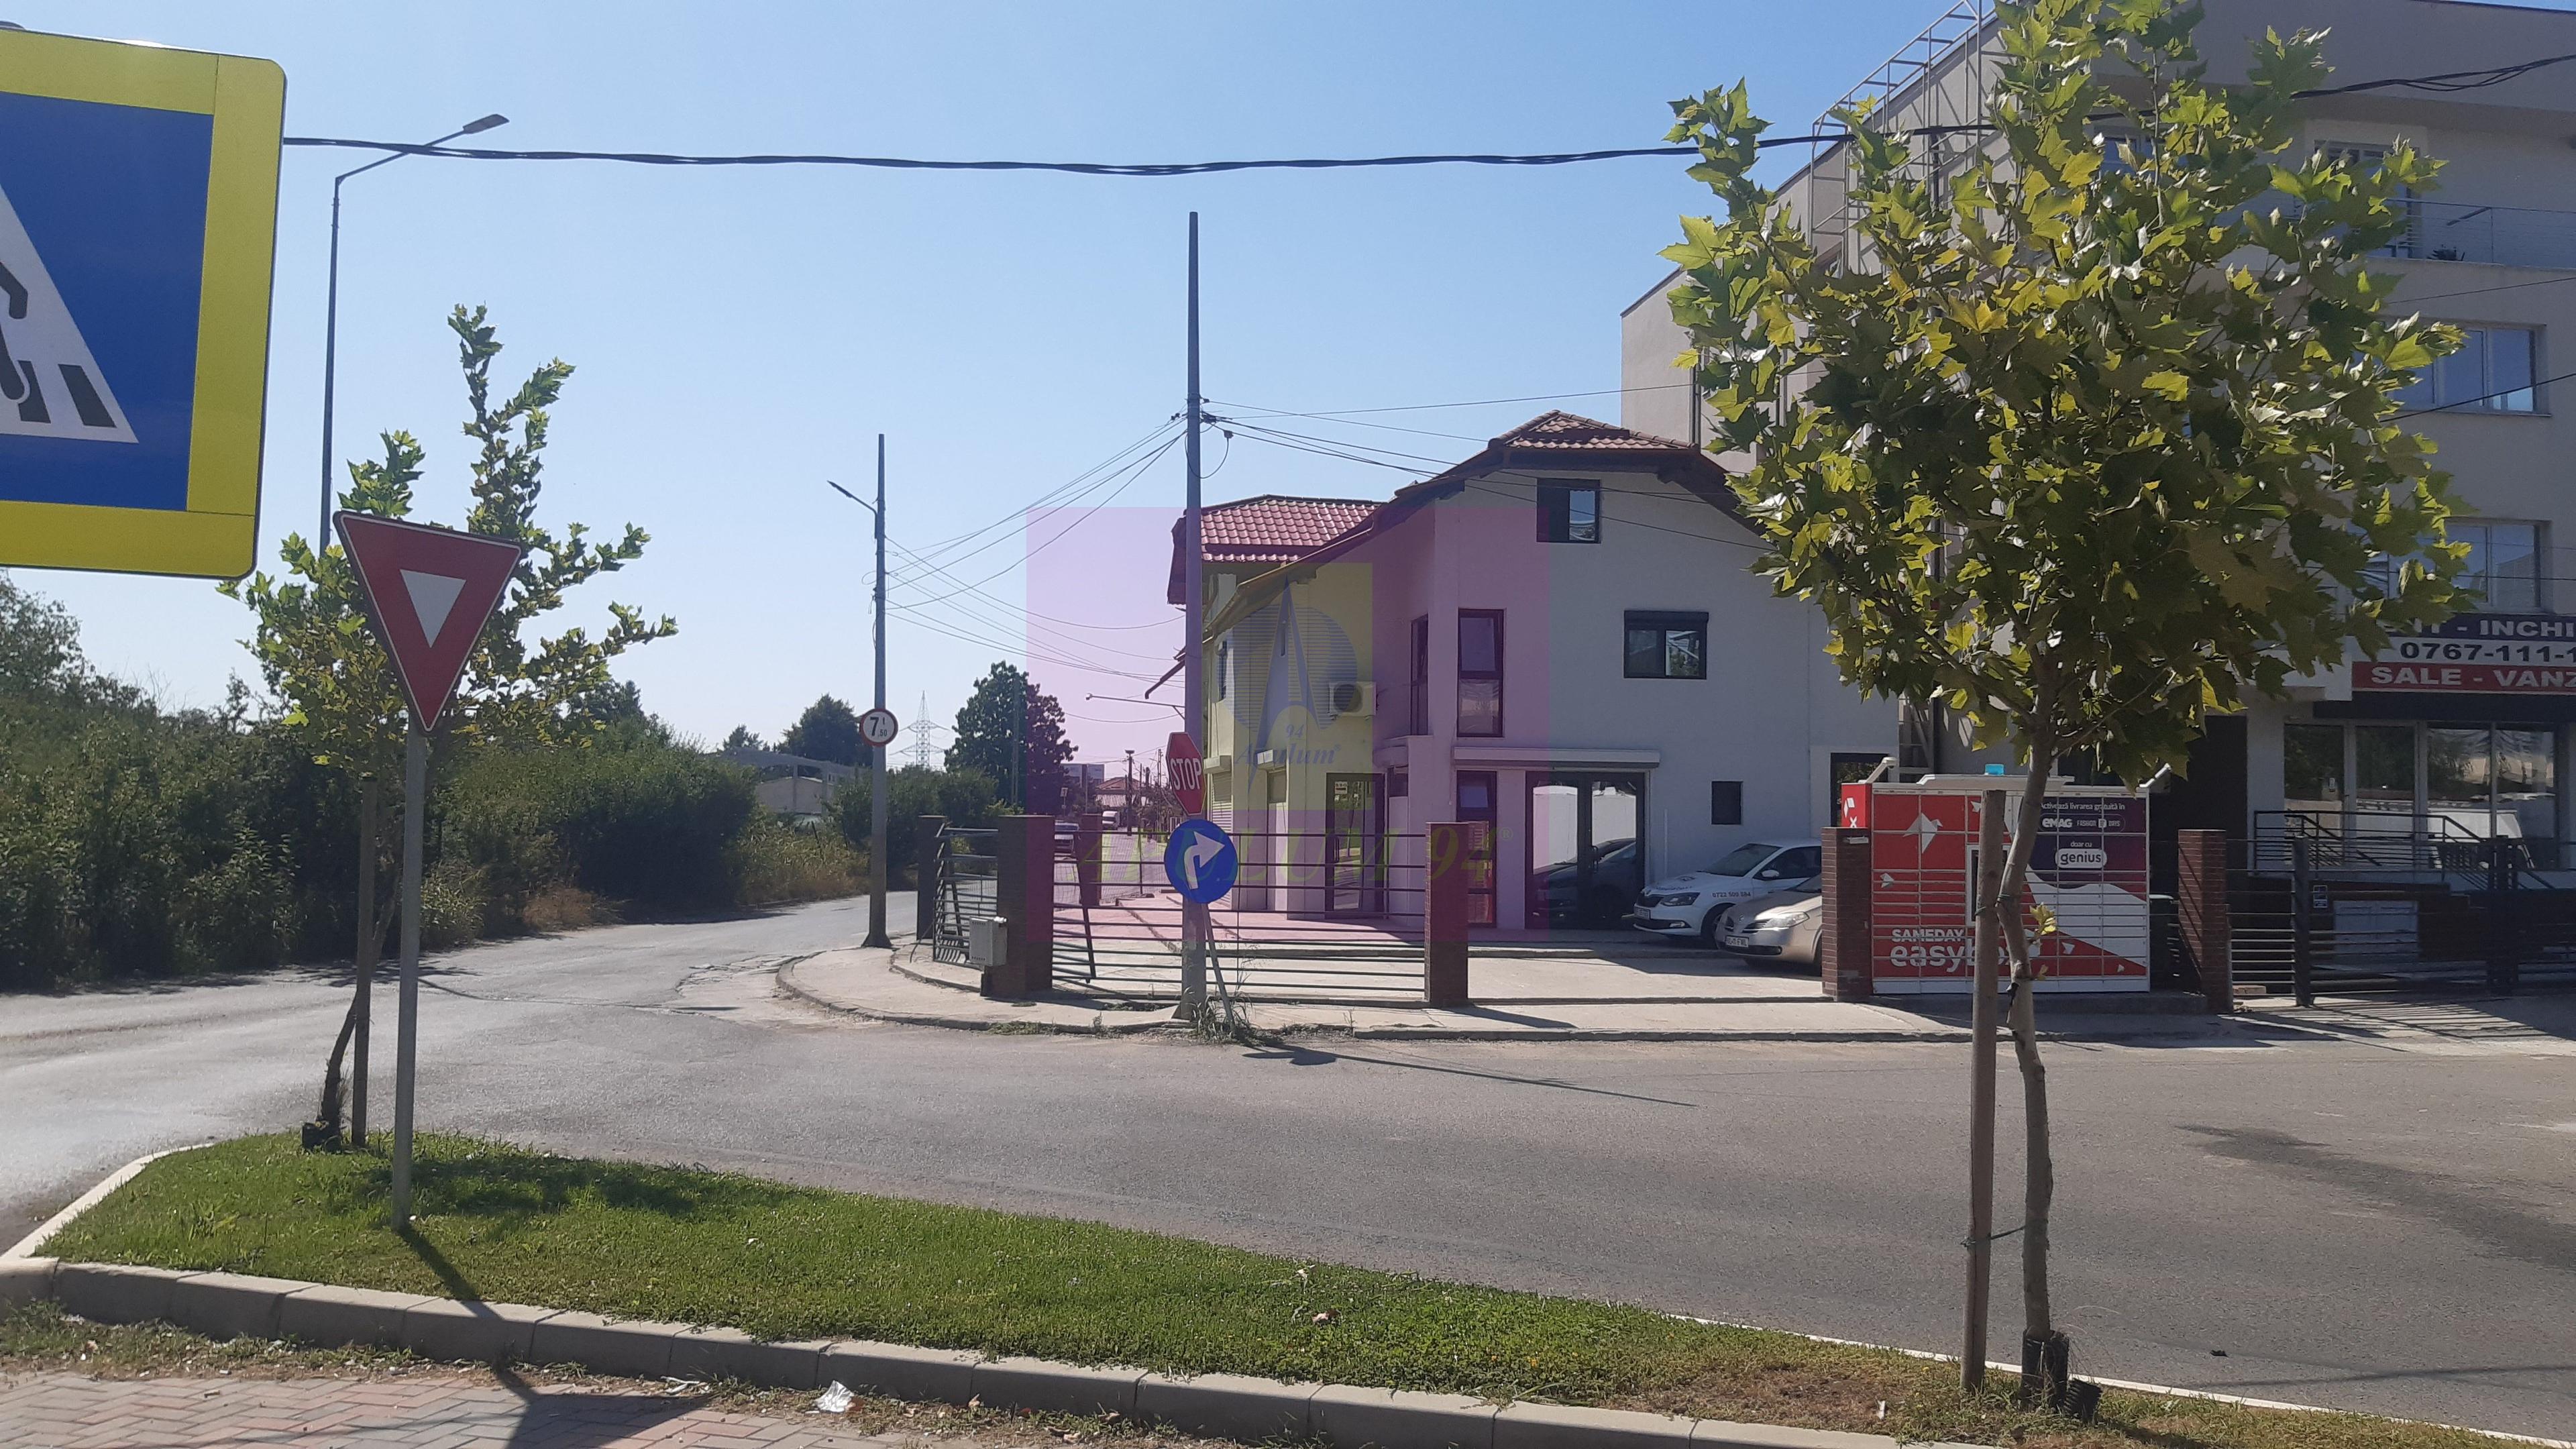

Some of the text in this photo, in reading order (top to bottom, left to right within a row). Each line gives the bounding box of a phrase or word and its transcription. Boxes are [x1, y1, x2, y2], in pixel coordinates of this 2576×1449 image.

[2479, 620, 2574, 637] INCHI
[2371, 667, 2462, 686] SALE
[2493, 670, 2576, 687] VANZ
[1170, 757, 1202, 790] STOP
[2060, 851, 2102, 865] genius
[1892, 928, 1964, 942] SAMEDAY
[1890, 938, 2010, 973] easyb
